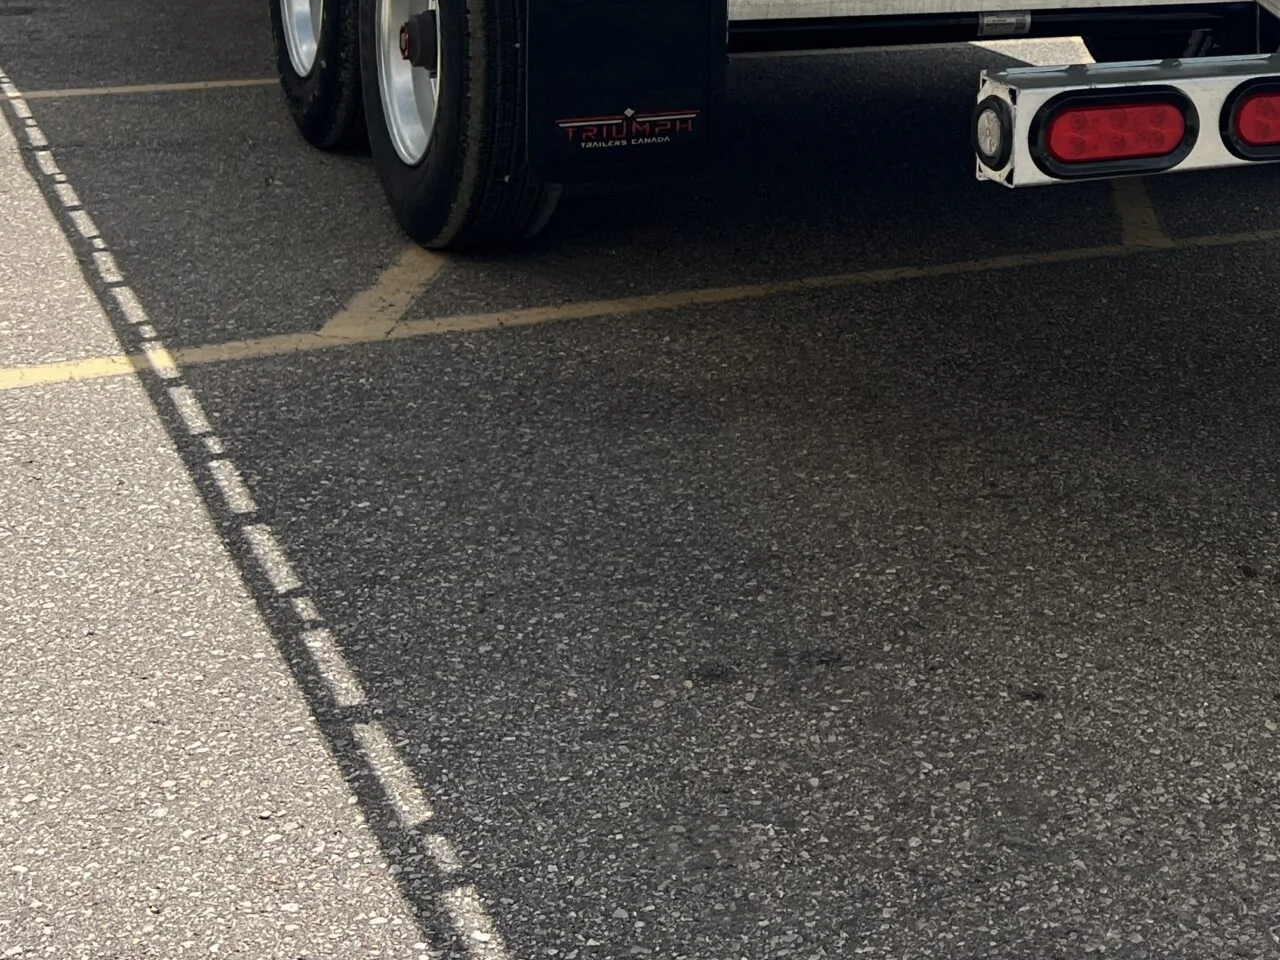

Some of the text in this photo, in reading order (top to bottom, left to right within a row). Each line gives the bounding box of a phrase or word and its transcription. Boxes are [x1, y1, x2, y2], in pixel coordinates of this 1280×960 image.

[564, 119, 693, 141] TRIUMPH
[580, 136, 671, 149] TRAILERS CANADA
